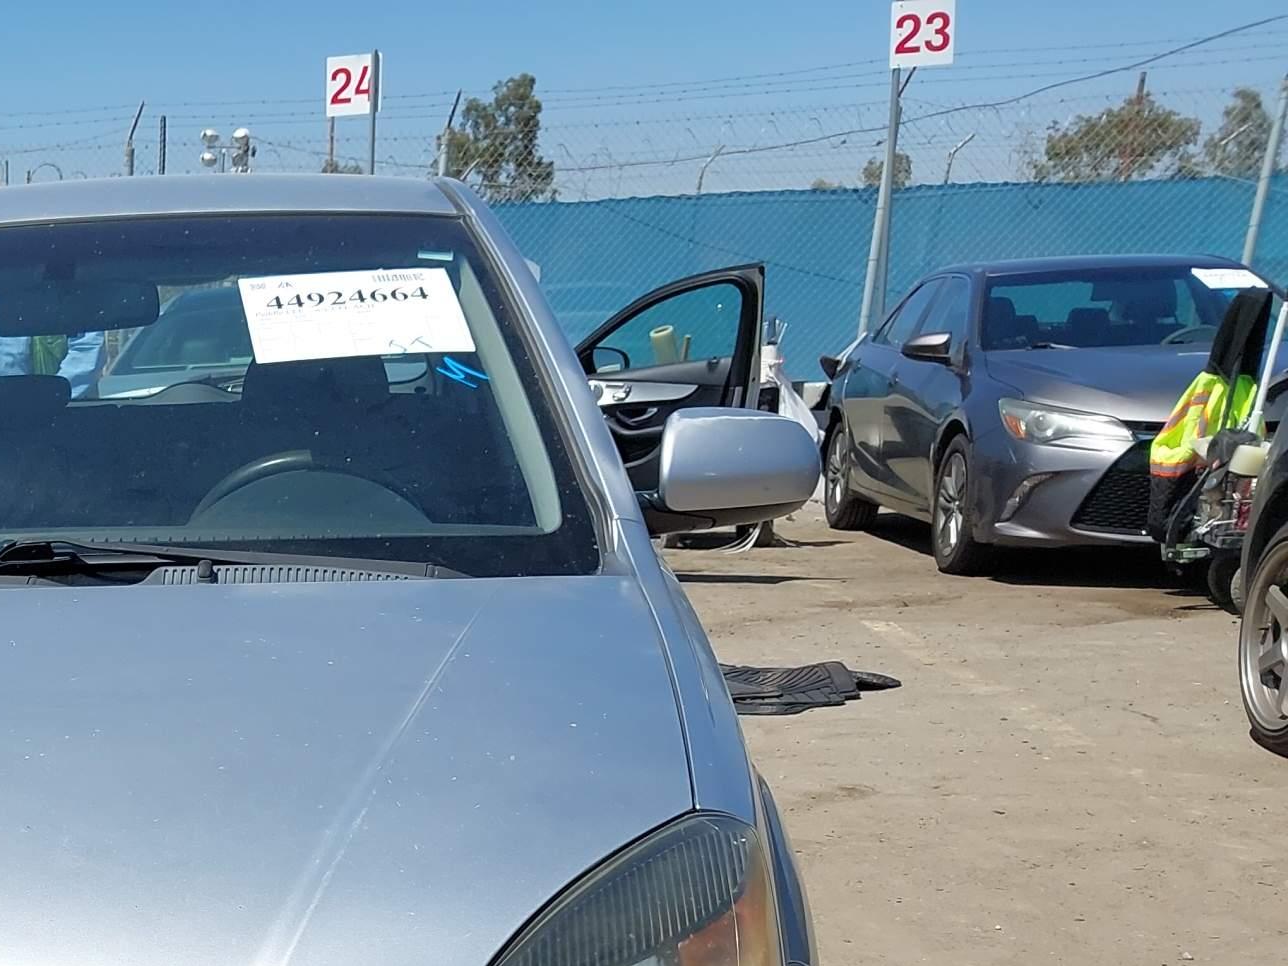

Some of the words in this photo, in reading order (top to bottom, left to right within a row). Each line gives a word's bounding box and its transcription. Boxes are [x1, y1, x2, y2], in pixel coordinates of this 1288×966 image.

[894, 11, 951, 54] 23
[330, 65, 372, 105] 24
[266, 286, 429, 310] 44924664
